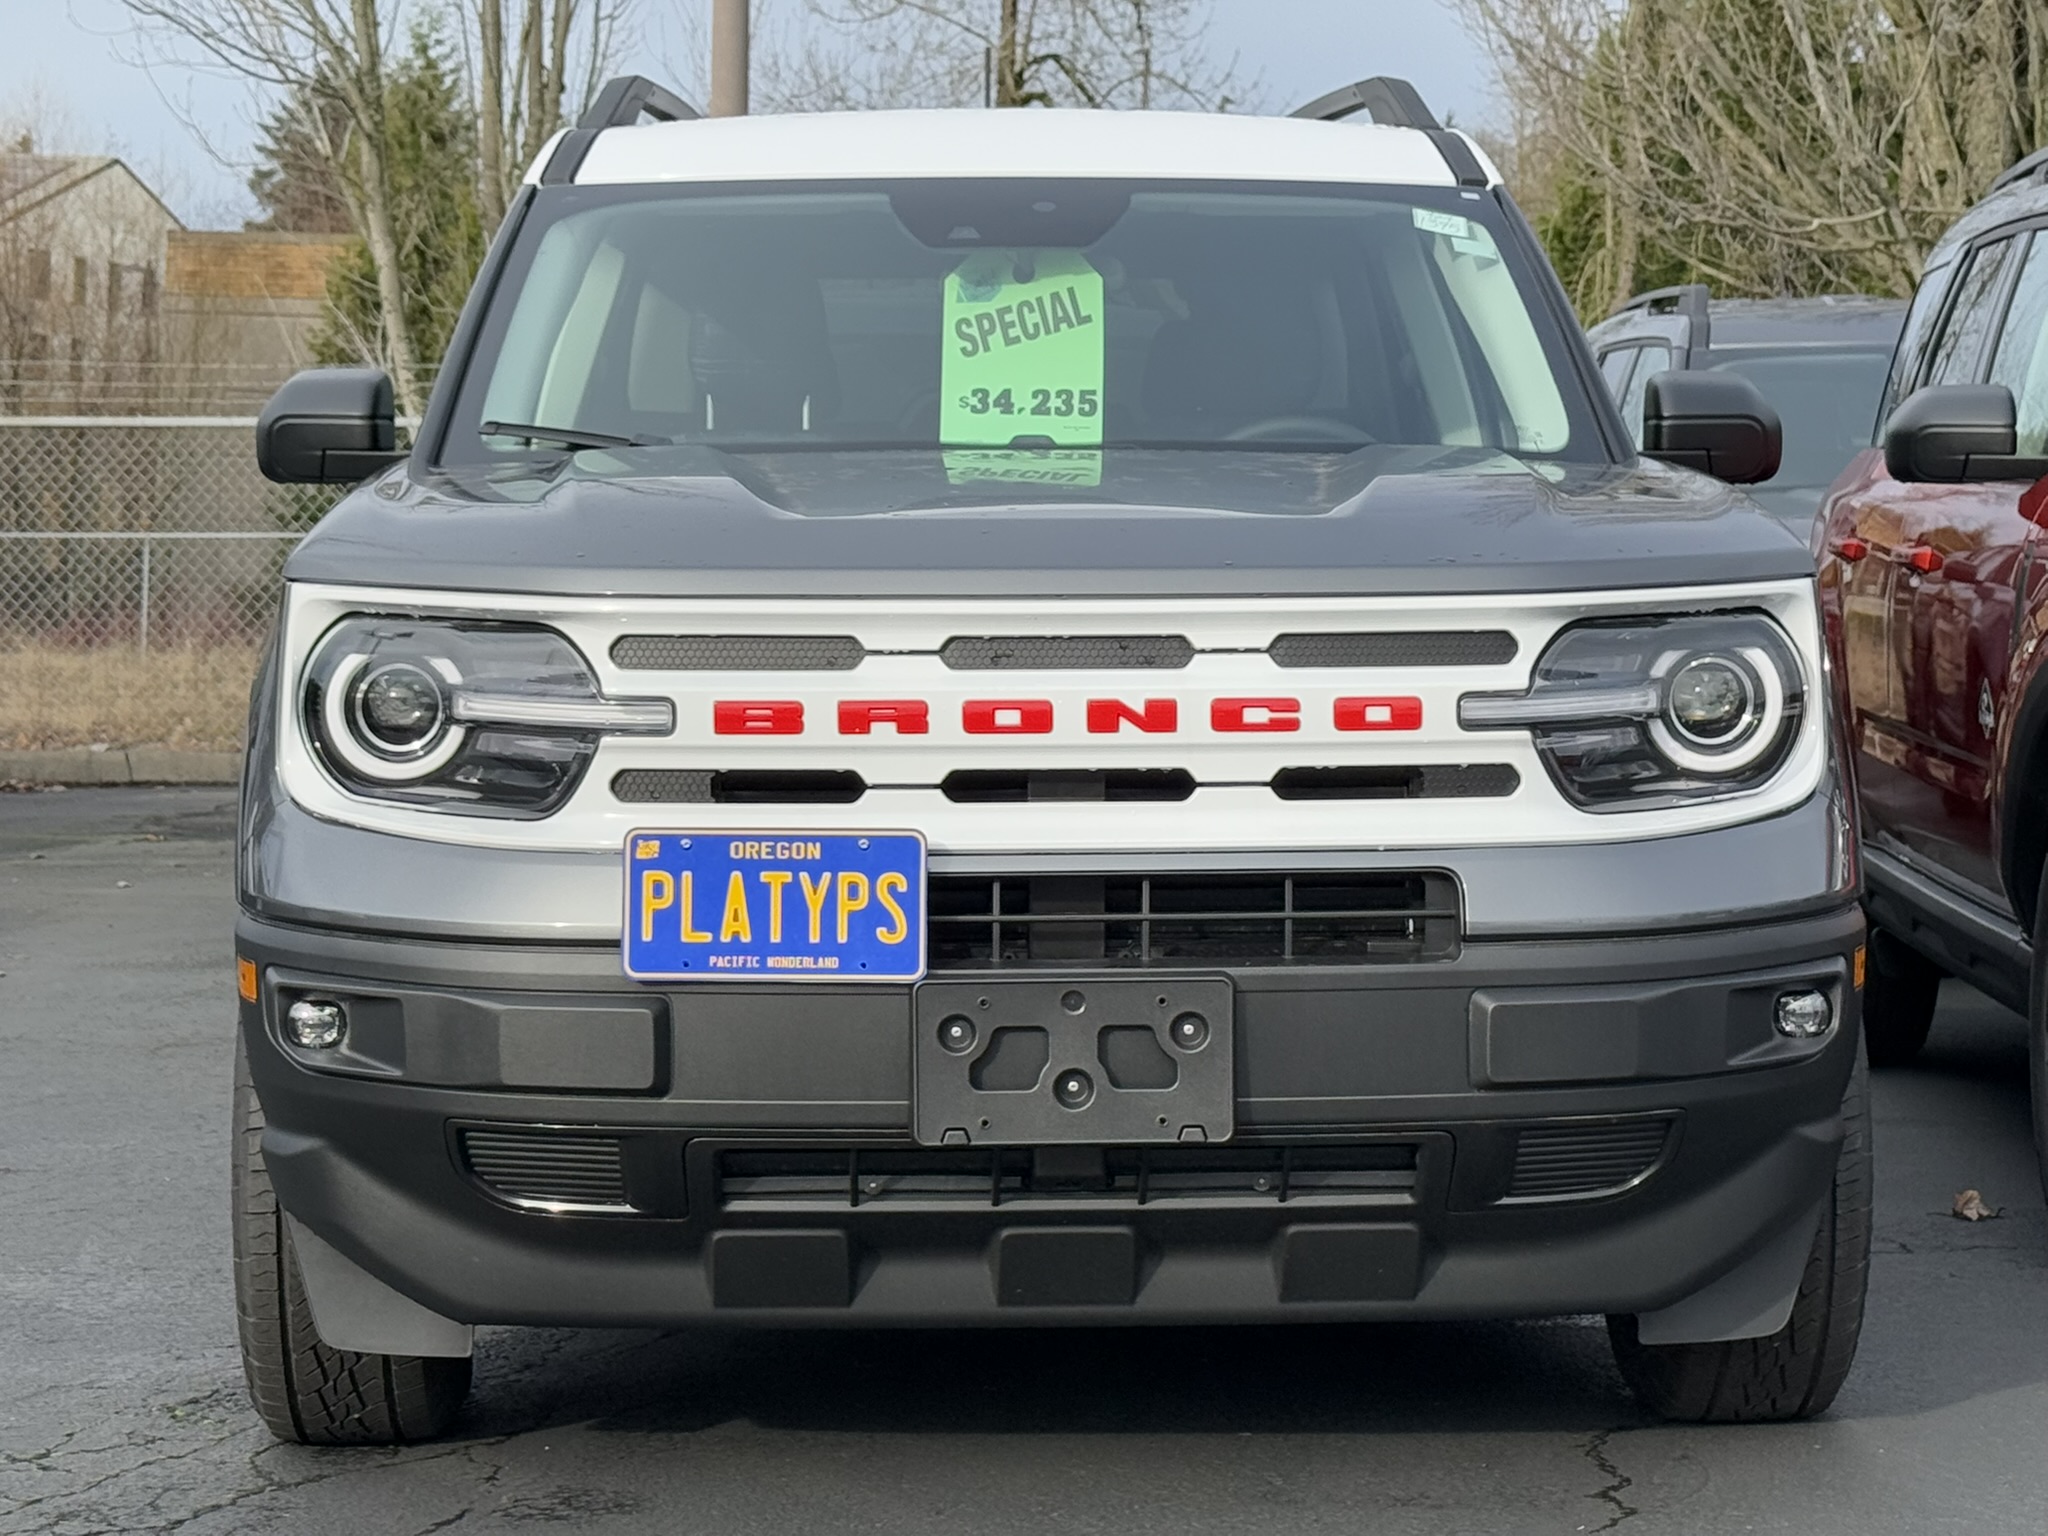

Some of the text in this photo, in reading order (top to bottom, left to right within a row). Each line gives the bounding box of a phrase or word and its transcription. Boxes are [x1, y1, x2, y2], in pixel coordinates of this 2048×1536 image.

[955, 286, 1093, 357] SPECIAL
[959, 388, 1098, 417] $34,235
[714, 697, 1423, 734] BRONCO
[730, 841, 821, 860] OREGON
[641, 870, 908, 945] PLATYPS
[709, 956, 839, 969] PACIFIC WONDERLAND
